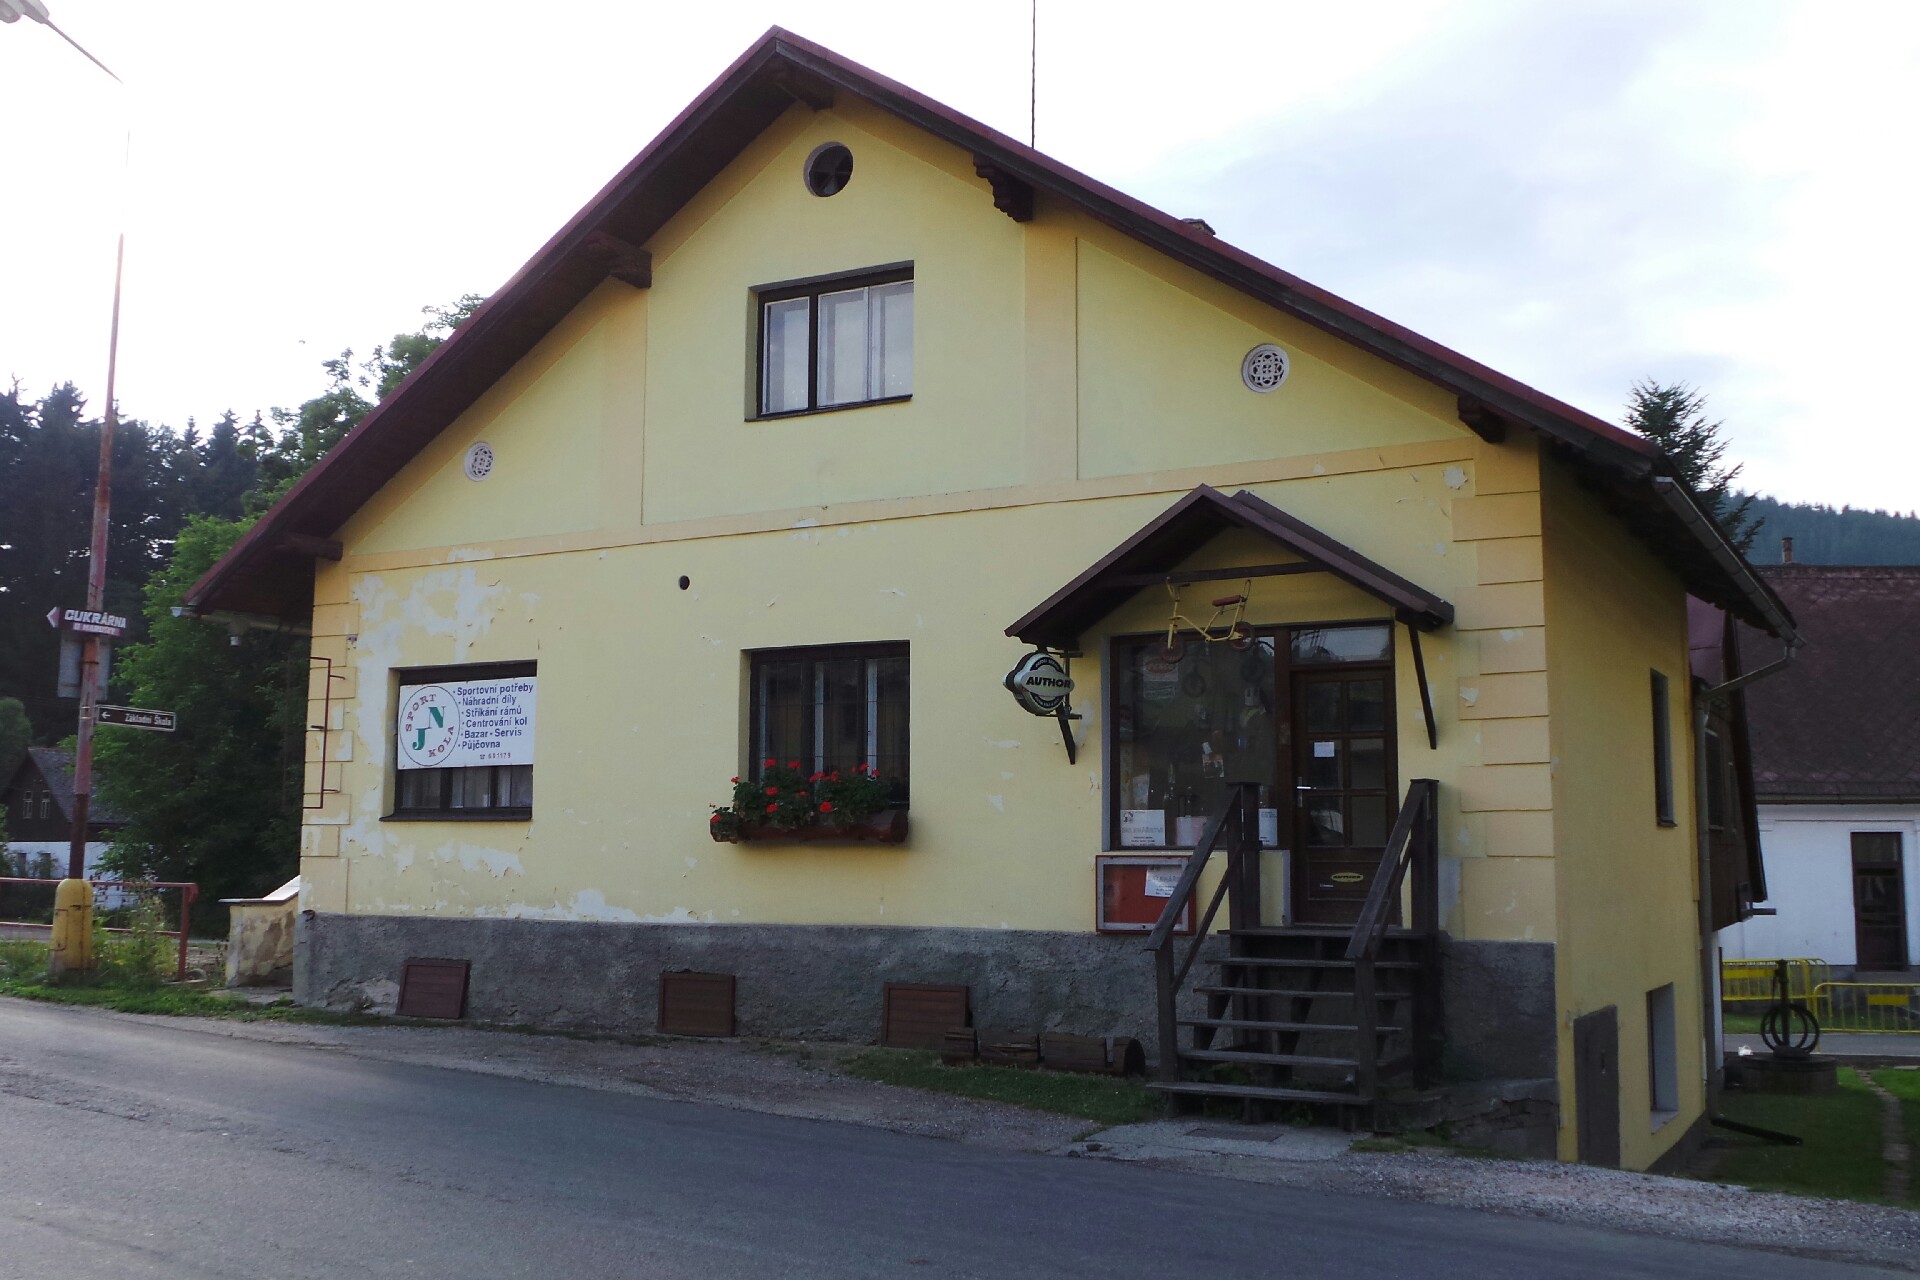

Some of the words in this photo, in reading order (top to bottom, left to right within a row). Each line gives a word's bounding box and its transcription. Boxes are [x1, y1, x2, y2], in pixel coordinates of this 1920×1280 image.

[64, 609, 127, 629] CUKRÁRNA
[1026, 676, 1071, 689] AUTHOR
[457, 684, 498, 697] Sportovní
[499, 682, 534, 694] potřeby
[462, 695, 499, 706] Náhradní
[501, 694, 517, 705] díly
[405, 694, 436, 732] SPORT
[500, 705, 522, 716] rámů
[466, 717, 512, 728] Centrování
[514, 716, 528, 726] kol
[464, 730, 488, 739] Bazar
[494, 727, 522, 737] Servis
[428, 726, 454, 758] KOLA
[462, 740, 501, 751] Půjčovna
